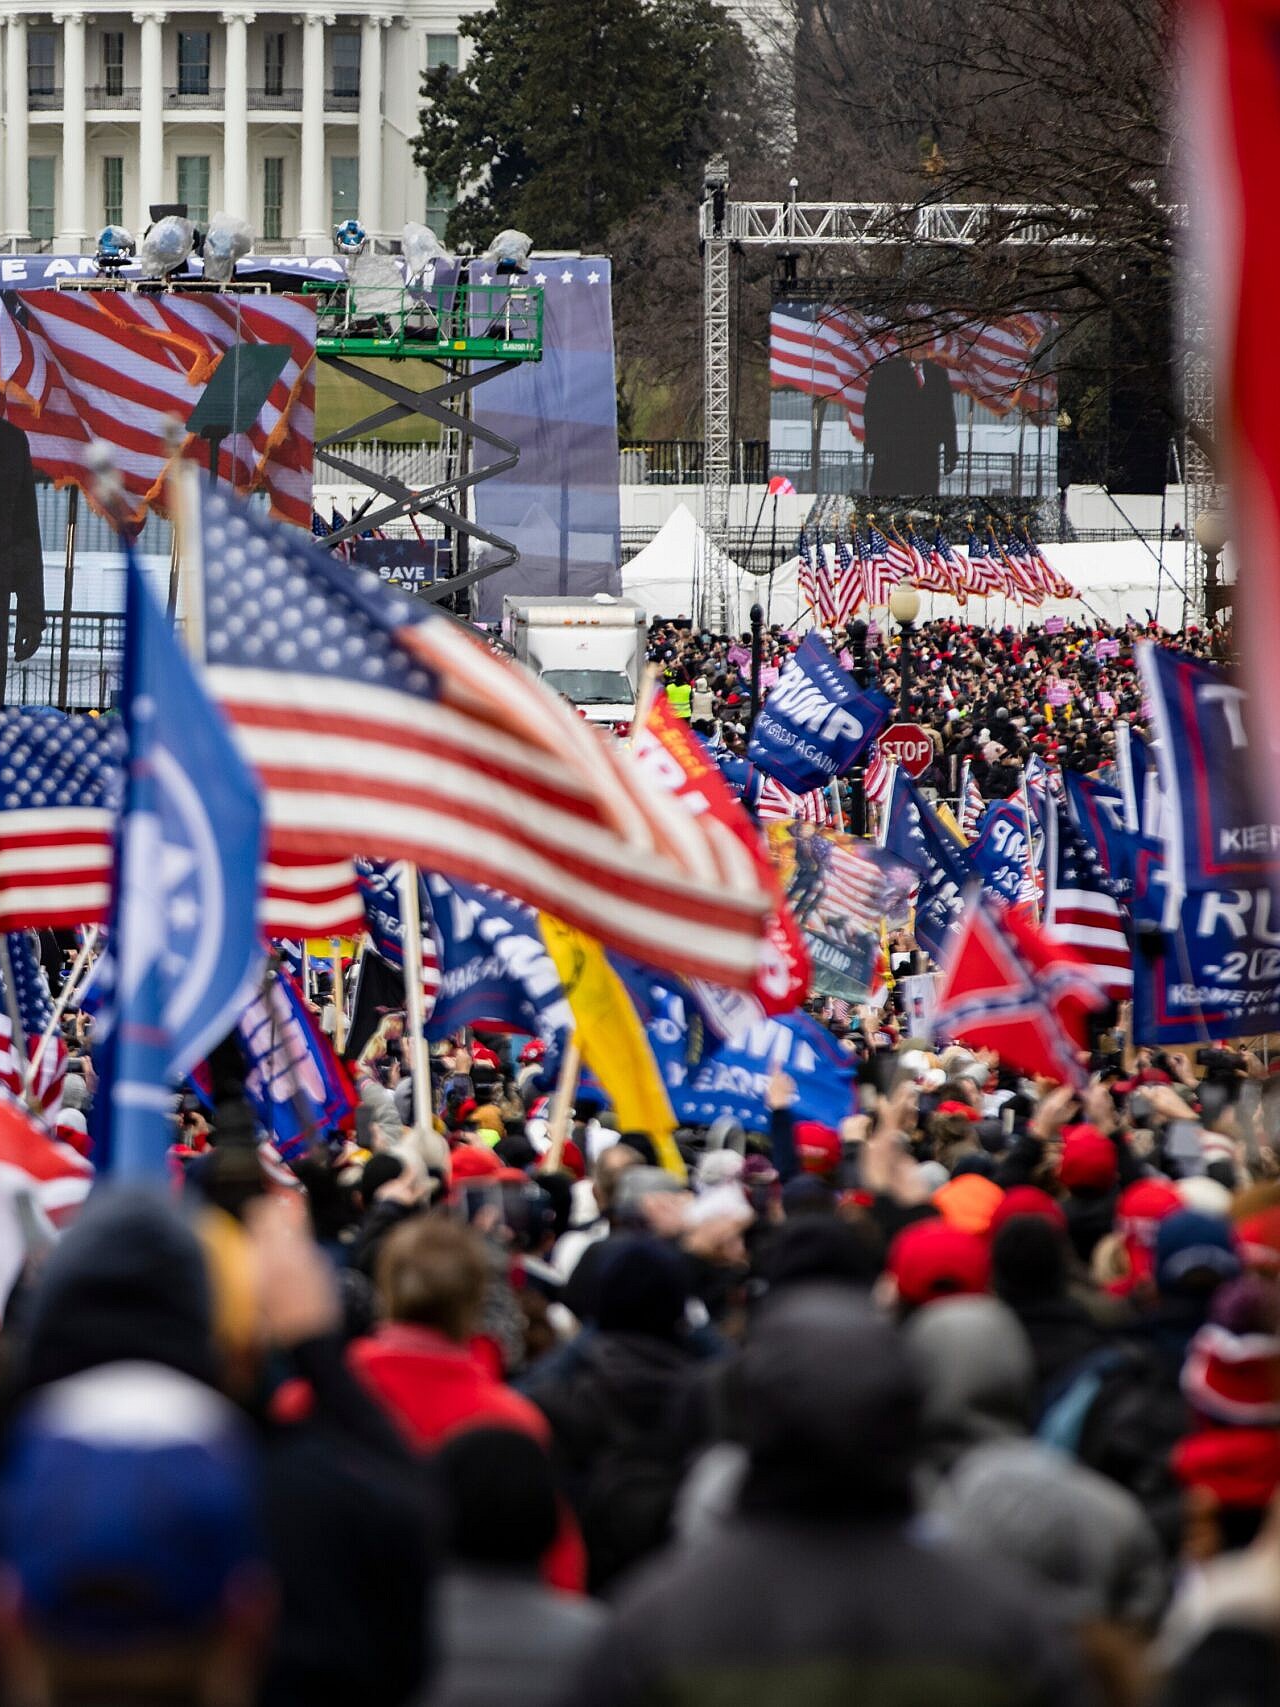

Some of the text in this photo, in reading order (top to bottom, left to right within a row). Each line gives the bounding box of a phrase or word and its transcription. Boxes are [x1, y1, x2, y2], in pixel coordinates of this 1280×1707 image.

[419, 485, 458, 503] SKYJACK
[379, 566, 425, 579] SAVE
[768, 723, 799, 746] GREAT
[795, 738, 840, 774] AGAIN!
[881, 740, 929, 762] STOP
